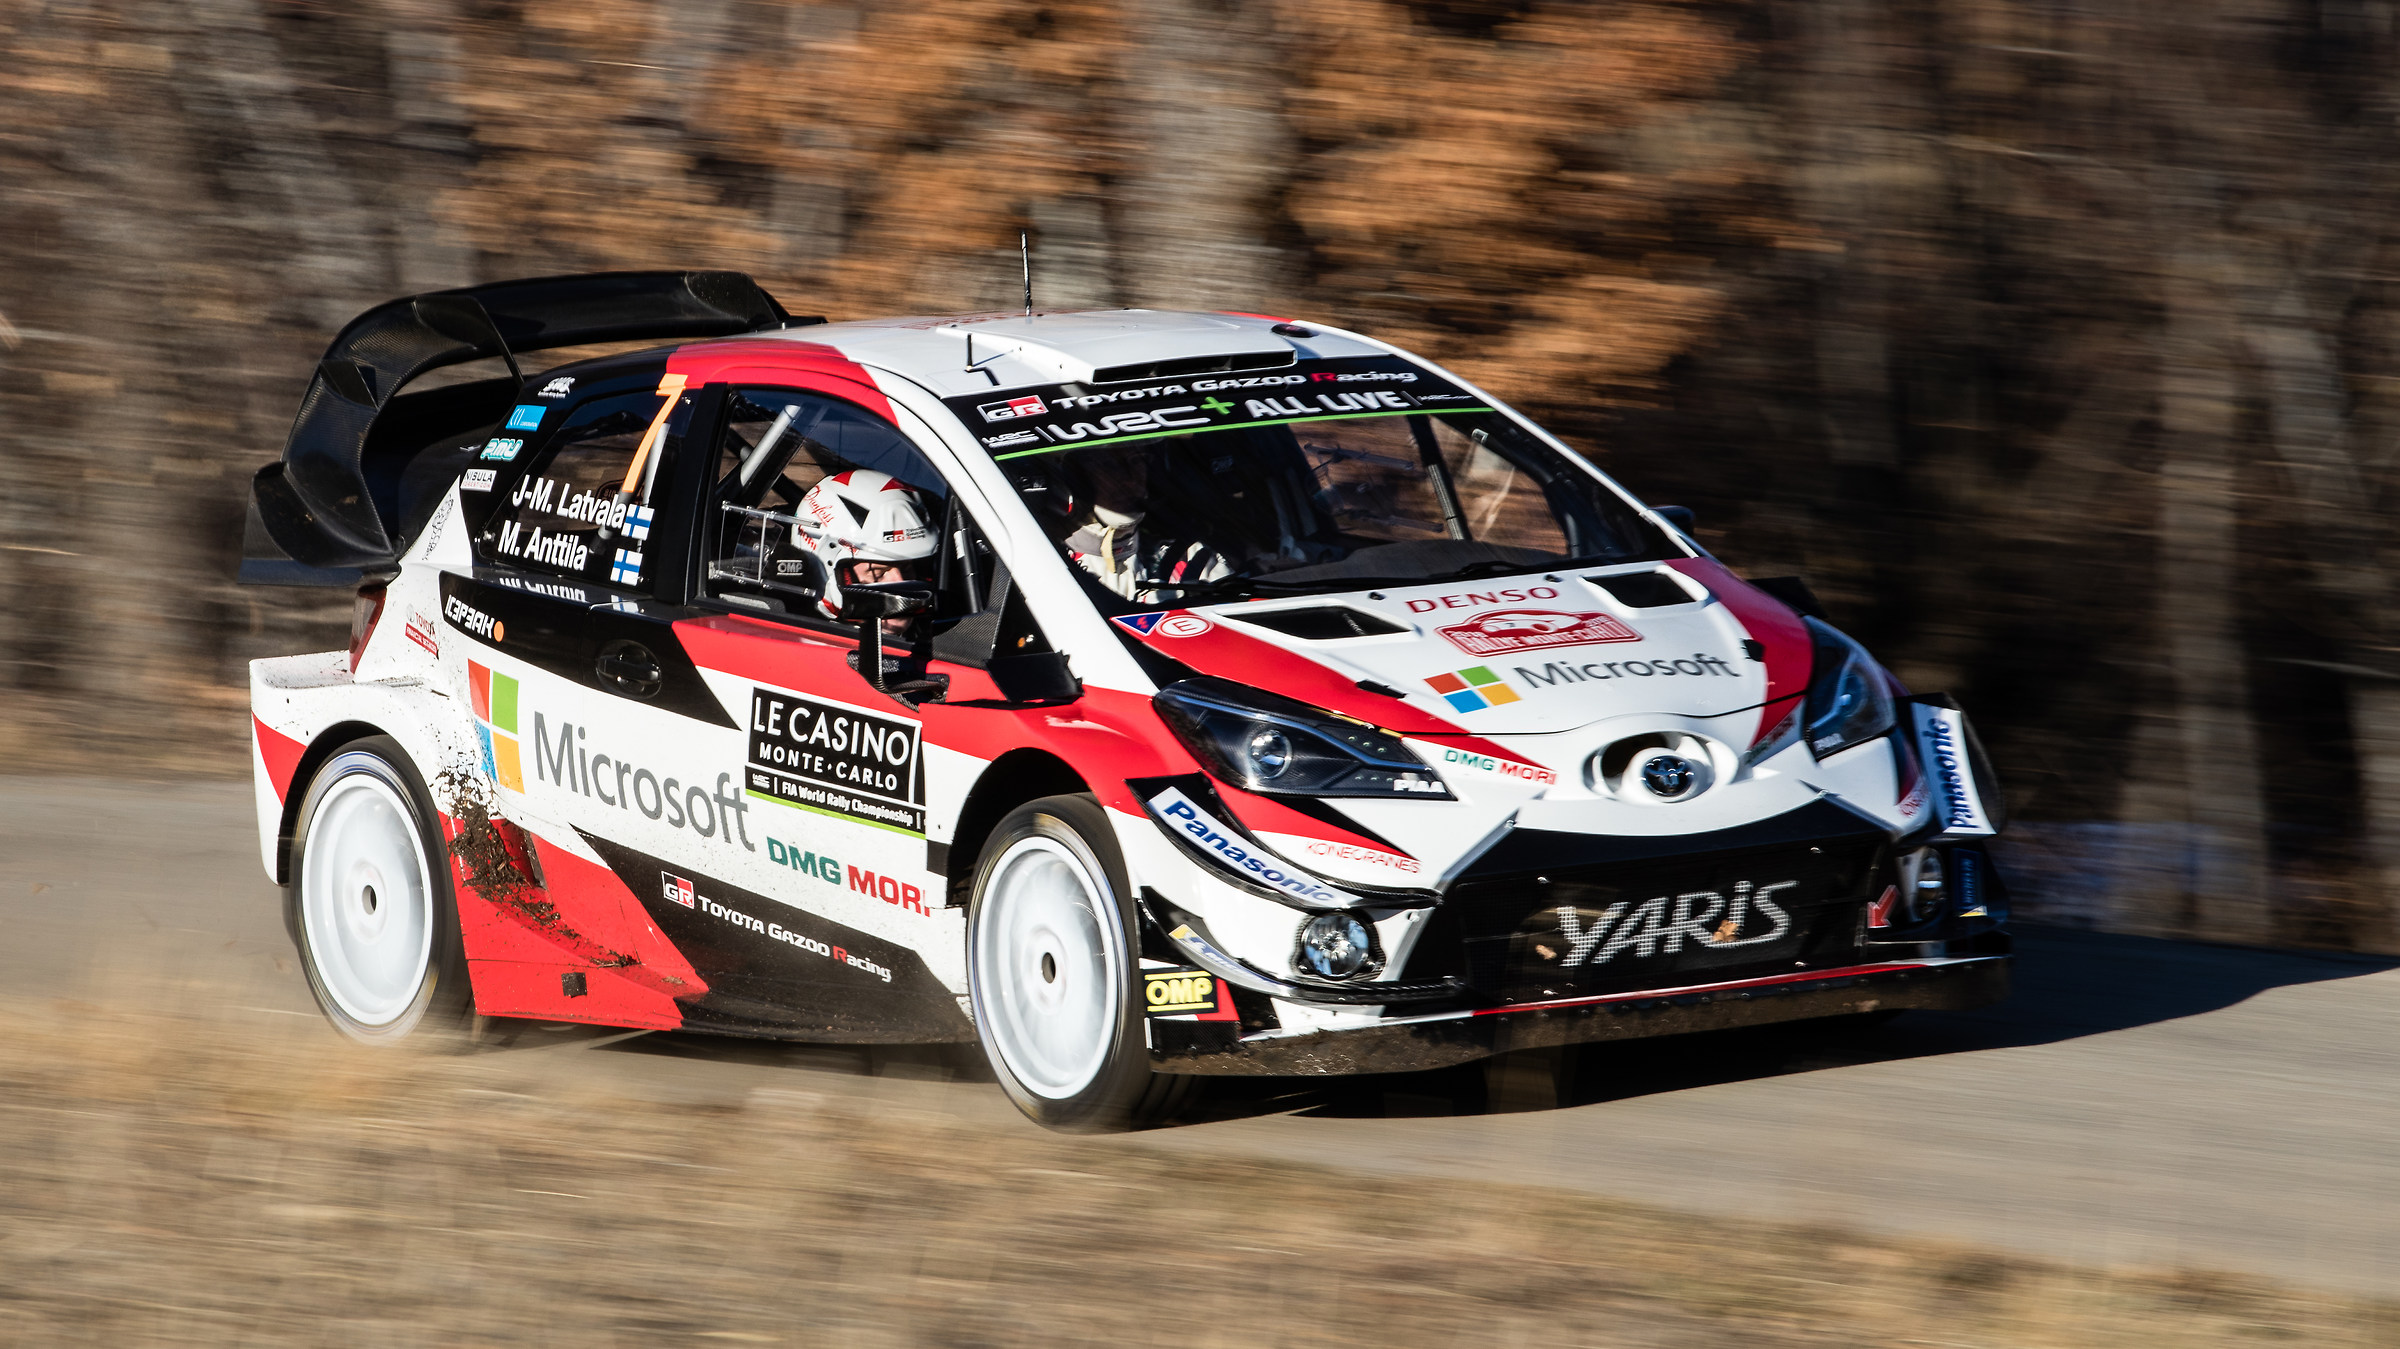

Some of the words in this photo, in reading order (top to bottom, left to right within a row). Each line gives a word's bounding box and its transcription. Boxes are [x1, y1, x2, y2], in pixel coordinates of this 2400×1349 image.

[1051, 384, 1187, 410] TOYOTA
[1191, 374, 1307, 392] GAZOO
[1310, 371, 1419, 383] Racing
[1245, 395, 1322, 418] ALL
[1316, 390, 1411, 412] LIVE
[986, 403, 1046, 421] GR
[622, 373, 688, 493] 7
[465, 471, 493, 482] NISULA
[513, 474, 555, 514] J-M.
[556, 483, 627, 529] Latvala
[498, 519, 521, 557] M.
[523, 526, 588, 571] Anttila
[777, 562, 803, 574] OMP
[1405, 586, 1559, 614] DENSO
[1172, 620, 1197, 632] E
[1459, 636, 1523, 653] RALLYE
[1513, 652, 1743, 689] Microsoft
[753, 696, 784, 736] LE
[789, 707, 909, 766] CASINO
[534, 711, 755, 852] Microsoft
[1445, 750, 1495, 771] DMG
[1499, 762, 1558, 785] MORI
[1923, 718, 1980, 828] Panasonic
[782, 781, 798, 796] FIA
[798, 785, 826, 804] World
[827, 793, 850, 811] Rally
[852, 799, 914, 826] Championship
[766, 836, 842, 885] DMG
[1163, 800, 1336, 903] Panasonic
[664, 882, 693, 907] GR
[698, 895, 764, 935] TOYOTA
[768, 923, 830, 957] GAZOO
[833, 946, 891, 983] Racing
[1146, 977, 1214, 1005] OMP
